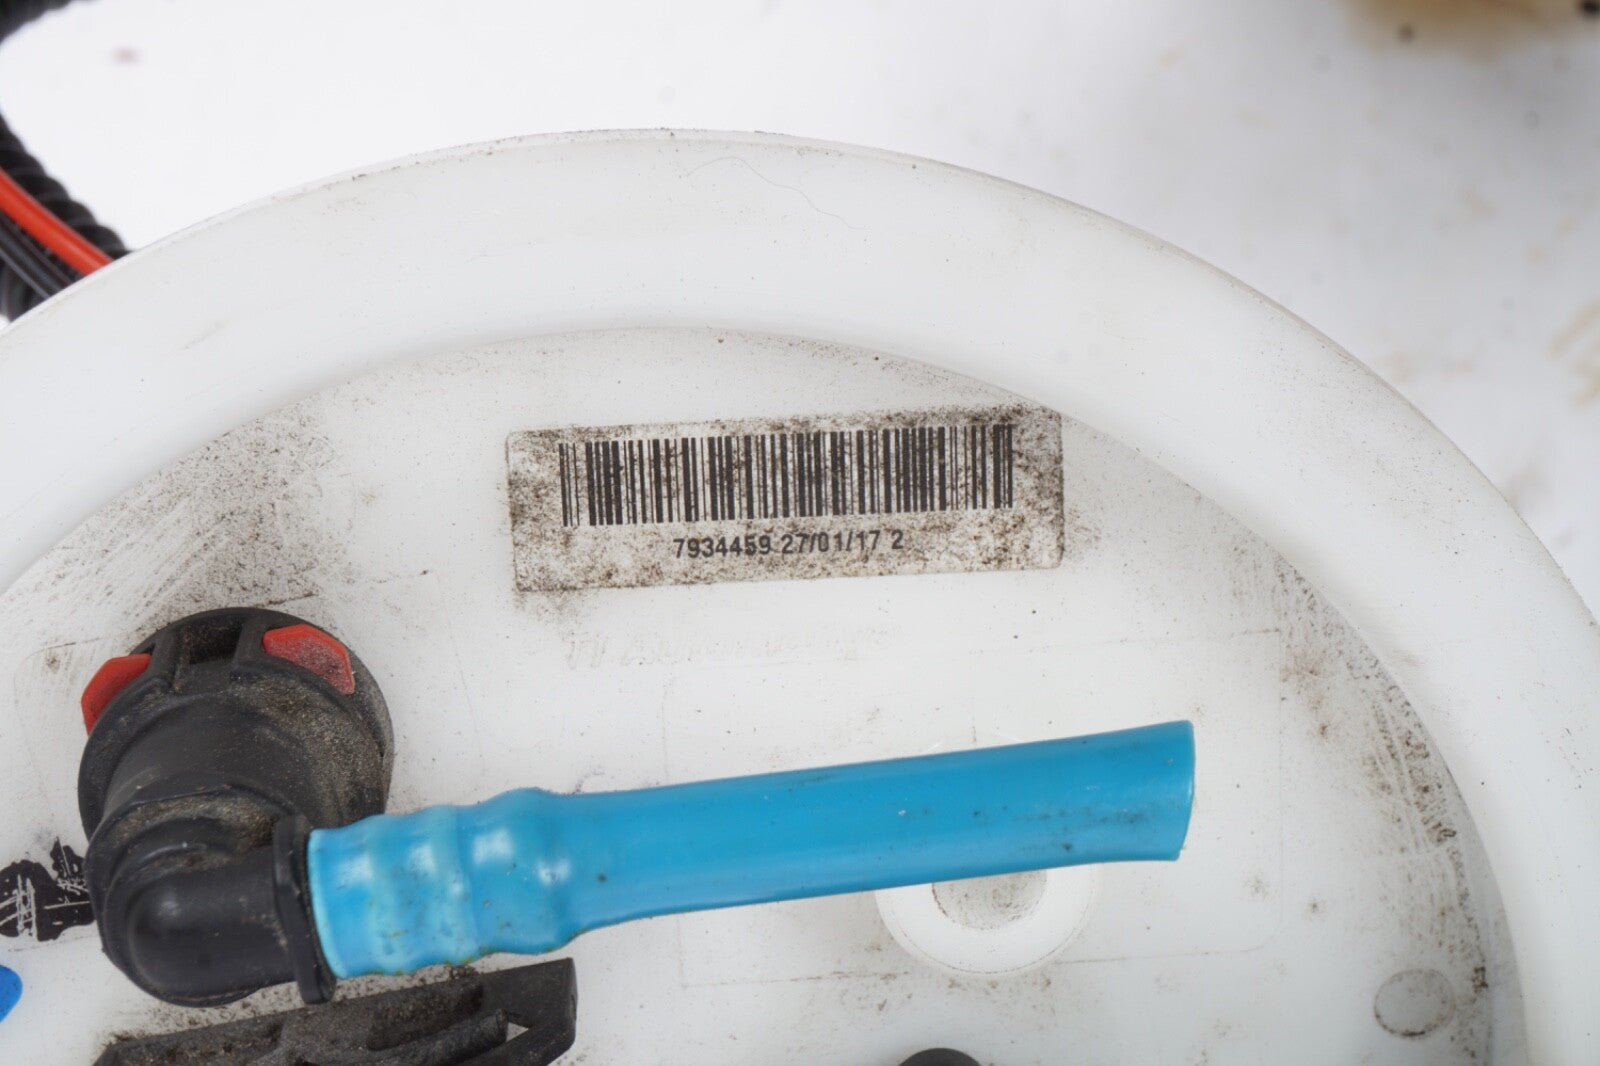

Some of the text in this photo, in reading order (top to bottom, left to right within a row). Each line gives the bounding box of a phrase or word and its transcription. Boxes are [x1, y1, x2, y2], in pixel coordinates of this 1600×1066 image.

[673, 529, 904, 558] 7934459 27/01/17 2
